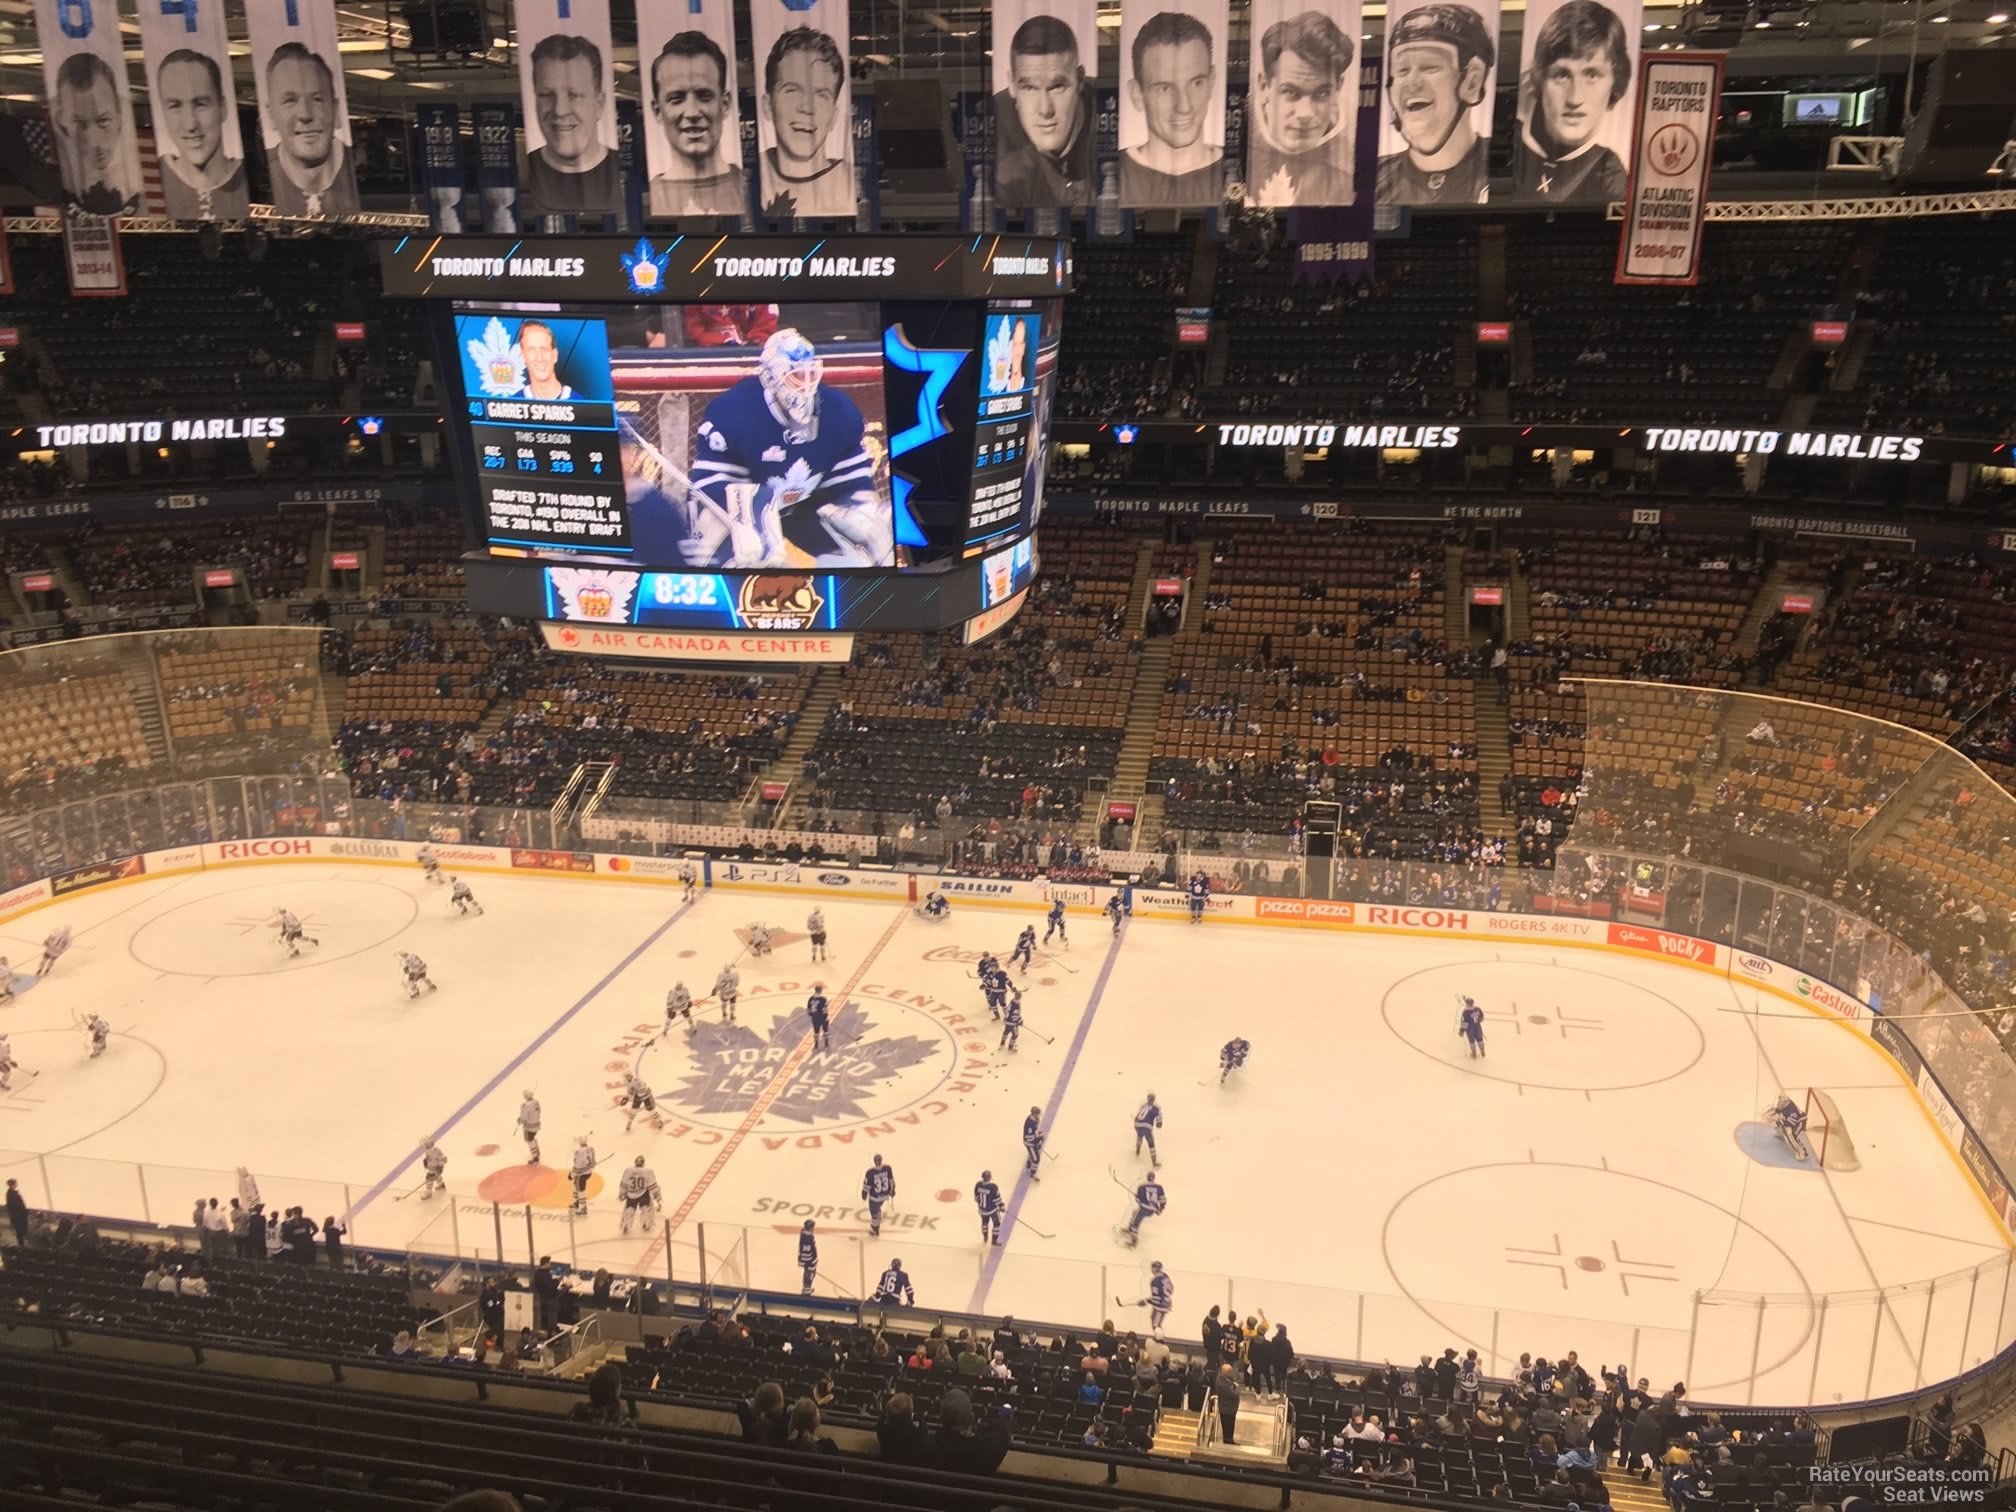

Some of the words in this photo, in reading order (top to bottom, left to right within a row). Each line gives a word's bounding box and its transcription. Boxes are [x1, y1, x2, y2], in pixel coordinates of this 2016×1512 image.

[1654, 80, 1707, 96] TORONTO
[1651, 97, 1705, 113] RAPTORS
[1642, 188, 1695, 202] ATLANTIC
[1639, 203, 1692, 219] DIVISION
[432, 257, 504, 277] TORONTO
[508, 258, 585, 277] MARLIES
[714, 257, 803, 277] TORONTO
[809, 257, 896, 277] MARLIES
[487, 401, 530, 420] GARRET
[530, 404, 576, 422] SPARKS
[37, 421, 162, 447] TORONTO
[172, 417, 286, 441] MARLIES
[535, 432, 571, 445] SEASON
[1219, 425, 1336, 446] TORONTO
[1343, 426, 1461, 448] MARLIES
[1645, 428, 1779, 454] TORONTO
[1787, 433, 1924, 461] MARLIES
[317, 490, 359, 501] LEAFS
[492, 489, 536, 504] DRAFTED
[537, 491, 559, 505] 7TH
[560, 494, 595, 508] ROUND
[596, 496, 611, 508] BY
[46, 503, 90, 516] LEAFS
[560, 507, 606, 522] OVERALL
[608, 511, 621, 522] IN
[1094, 500, 1150, 512] TORONTO
[1159, 501, 1200, 513] MAPLE
[1208, 502, 1249, 514] LEAFS
[1315, 503, 1336, 515] 120
[1461, 507, 1481, 518] THE
[1485, 507, 1523, 519] NORTH
[1636, 511, 1658, 523] 121
[489, 515, 510, 528] THE
[553, 522, 587, 534] ENTRY
[588, 523, 622, 536] DRAFT
[1751, 515, 1795, 529] TORONTO
[1797, 518, 1843, 532] RAPTORS
[1845, 521, 1908, 537] BASKETBALL
[655, 574, 717, 606] 8:32
[757, 617, 801, 630] BEARS
[592, 633, 626, 646] AIR
[637, 635, 731, 652] CANADA
[741, 639, 832, 653] CENTRE
[220, 840, 312, 859] RICOH
[823, 874, 846, 886] Ford
[940, 881, 1013, 894] SAILUN
[1260, 900, 1304, 915] pizza
[1306, 902, 1350, 918] pizza
[1368, 907, 1468, 930] RICOH
[1489, 918, 1546, 932] ROGERS
[1551, 922, 1569, 933] 4K
[1573, 924, 1591, 935] TV
[1811, 985, 1857, 1020] Castrol
[612, 1023, 662, 1055] AIR
[861, 983, 979, 1036] CENTRE
[760, 1099, 949, 1151] CANADA
[629, 1176, 645, 1191] 30
[874, 1178, 888, 1193] 33
[752, 1197, 941, 1230] SPORTCHEK
[884, 1275, 897, 1293] 16
[1223, 1339, 1236, 1353] 13
[1461, 1373, 1473, 1384] 34
[1541, 1379, 1551, 1392] 16
